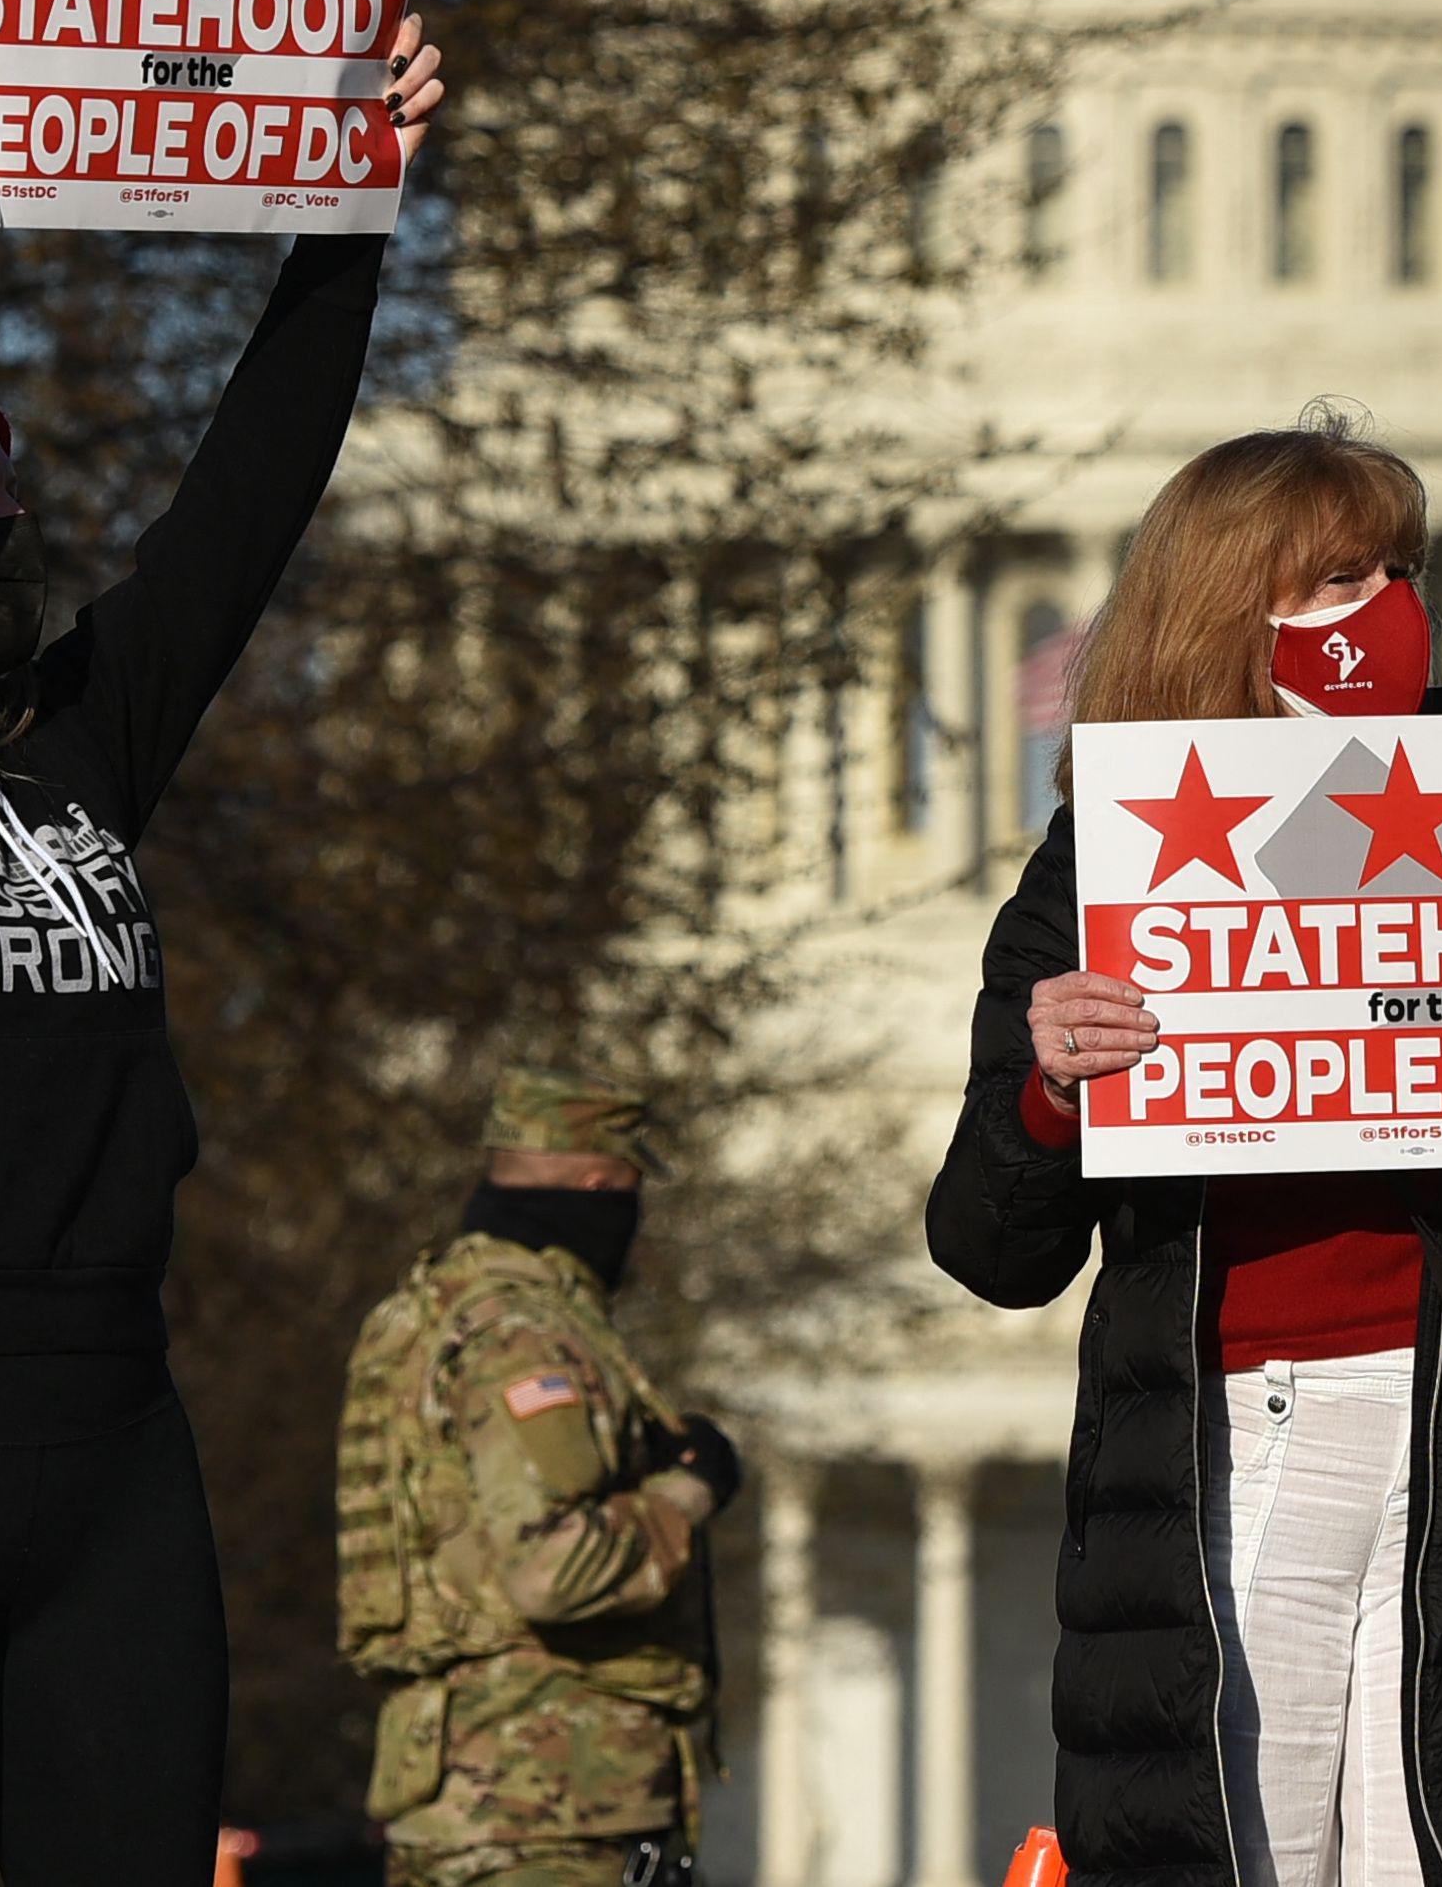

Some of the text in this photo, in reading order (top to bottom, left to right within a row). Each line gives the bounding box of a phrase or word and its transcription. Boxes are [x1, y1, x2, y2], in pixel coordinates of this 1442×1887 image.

[141, 54, 233, 87] for the
[203, 101, 290, 182] OF
[293, 107, 373, 184] DC
[119, 187, 189, 203] @51for51
[261, 192, 339, 209] @DC_Vote
[1328, 642, 1358, 662] 51
[1368, 991, 1423, 1023] for
[1129, 1035, 1442, 1120] PEOPLE
[1185, 1129, 1276, 1144] @51stDC
